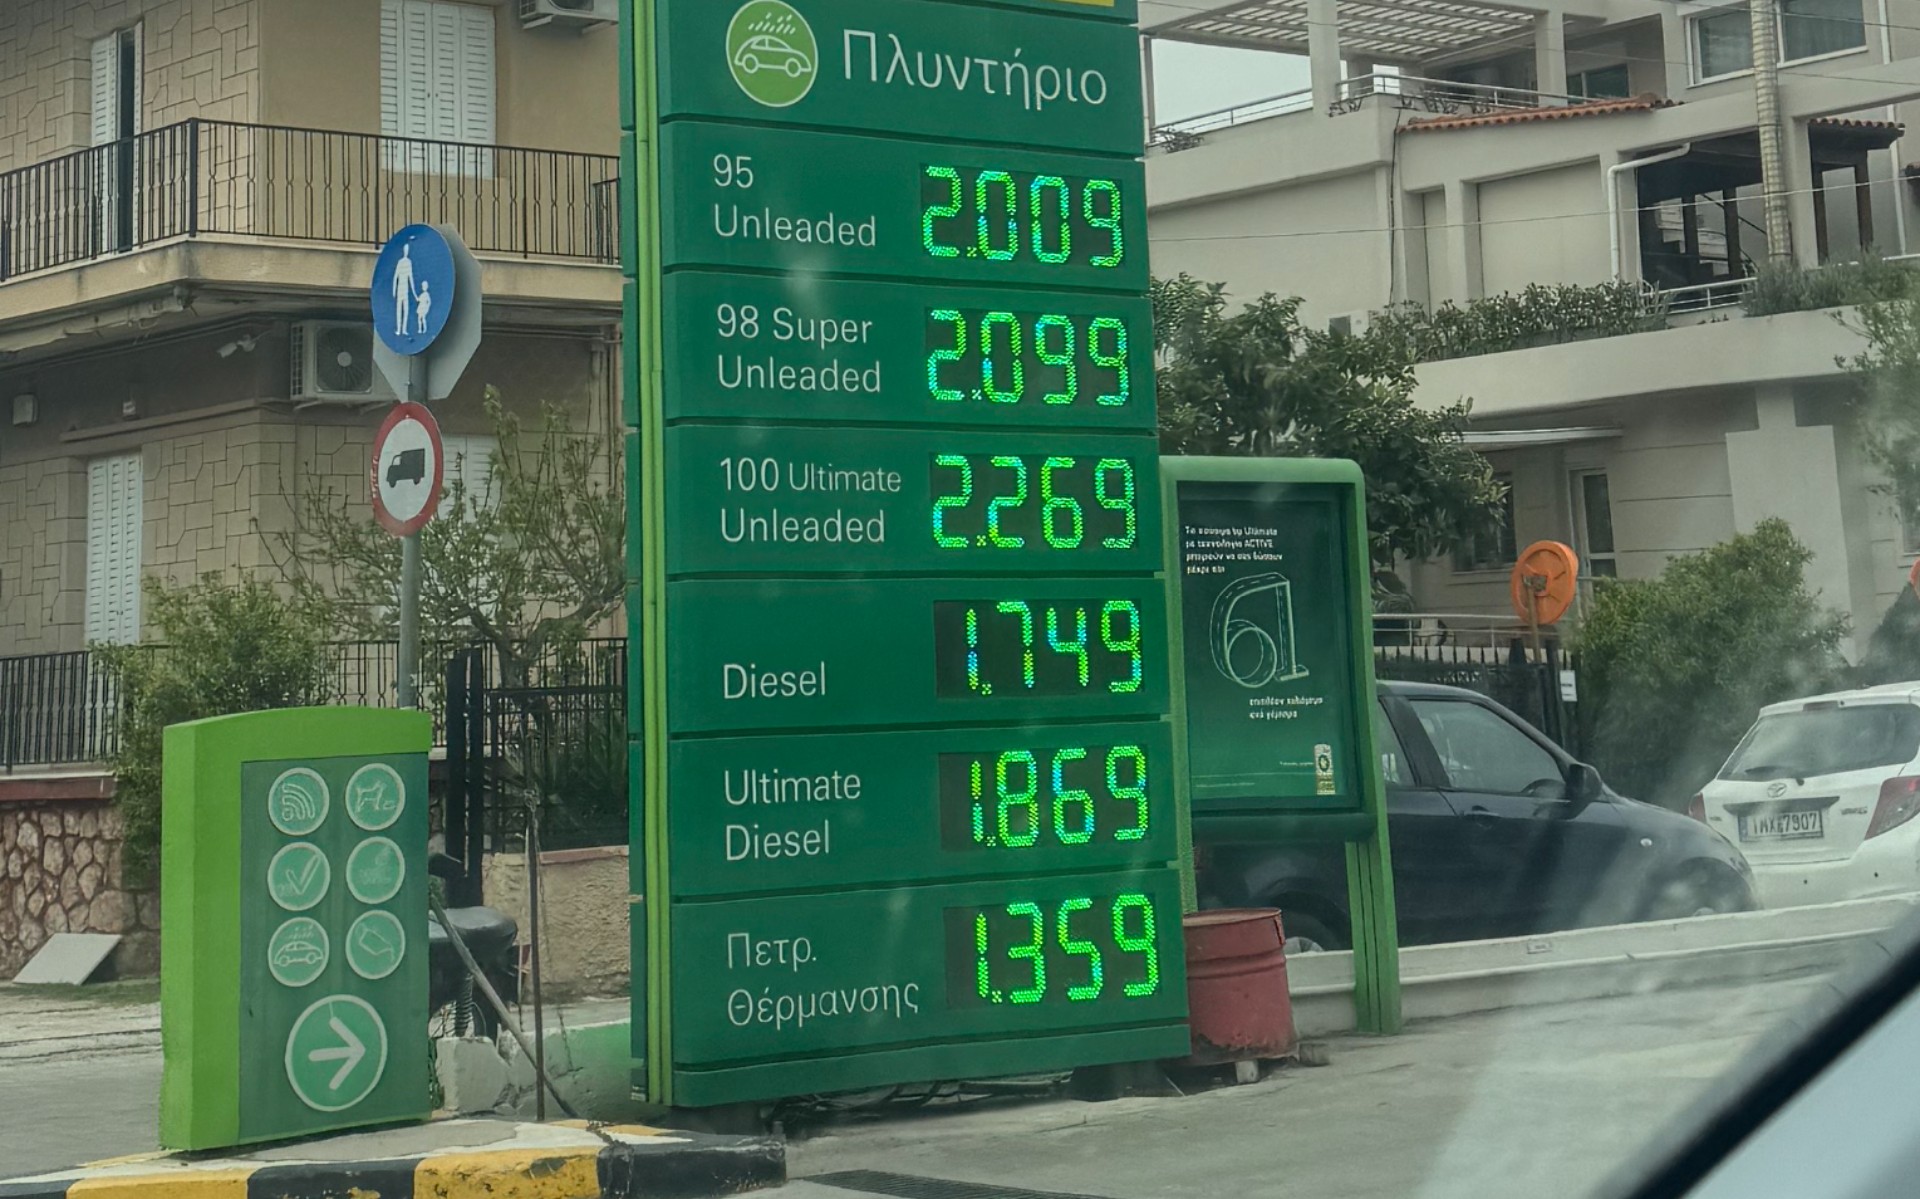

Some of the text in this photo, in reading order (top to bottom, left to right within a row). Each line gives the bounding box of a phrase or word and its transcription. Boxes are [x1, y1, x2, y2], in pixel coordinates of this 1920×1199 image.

[843, 28, 1107, 111] Πλυντήριο
[712, 153, 755, 189] 95
[713, 203, 877, 247] Unleaded
[922, 165, 1124, 267] 2.009
[716, 303, 873, 350] 98 Super
[717, 354, 882, 394] Unleaded
[926, 309, 1130, 406] 2.099
[720, 457, 902, 493] 100 Ultimate
[932, 454, 1136, 549] 2.269
[720, 507, 885, 543] Unleaded
[966, 599, 1143, 695] 1.749
[722, 661, 827, 700] Diesel
[723, 768, 861, 806] Ultimate
[971, 744, 1149, 848] 1.869
[724, 819, 831, 861] Diesel
[727, 932, 818, 973] Πετρ.
[975, 893, 1159, 1004] 1.359
[727, 982, 920, 1031] Θέρμανσης
